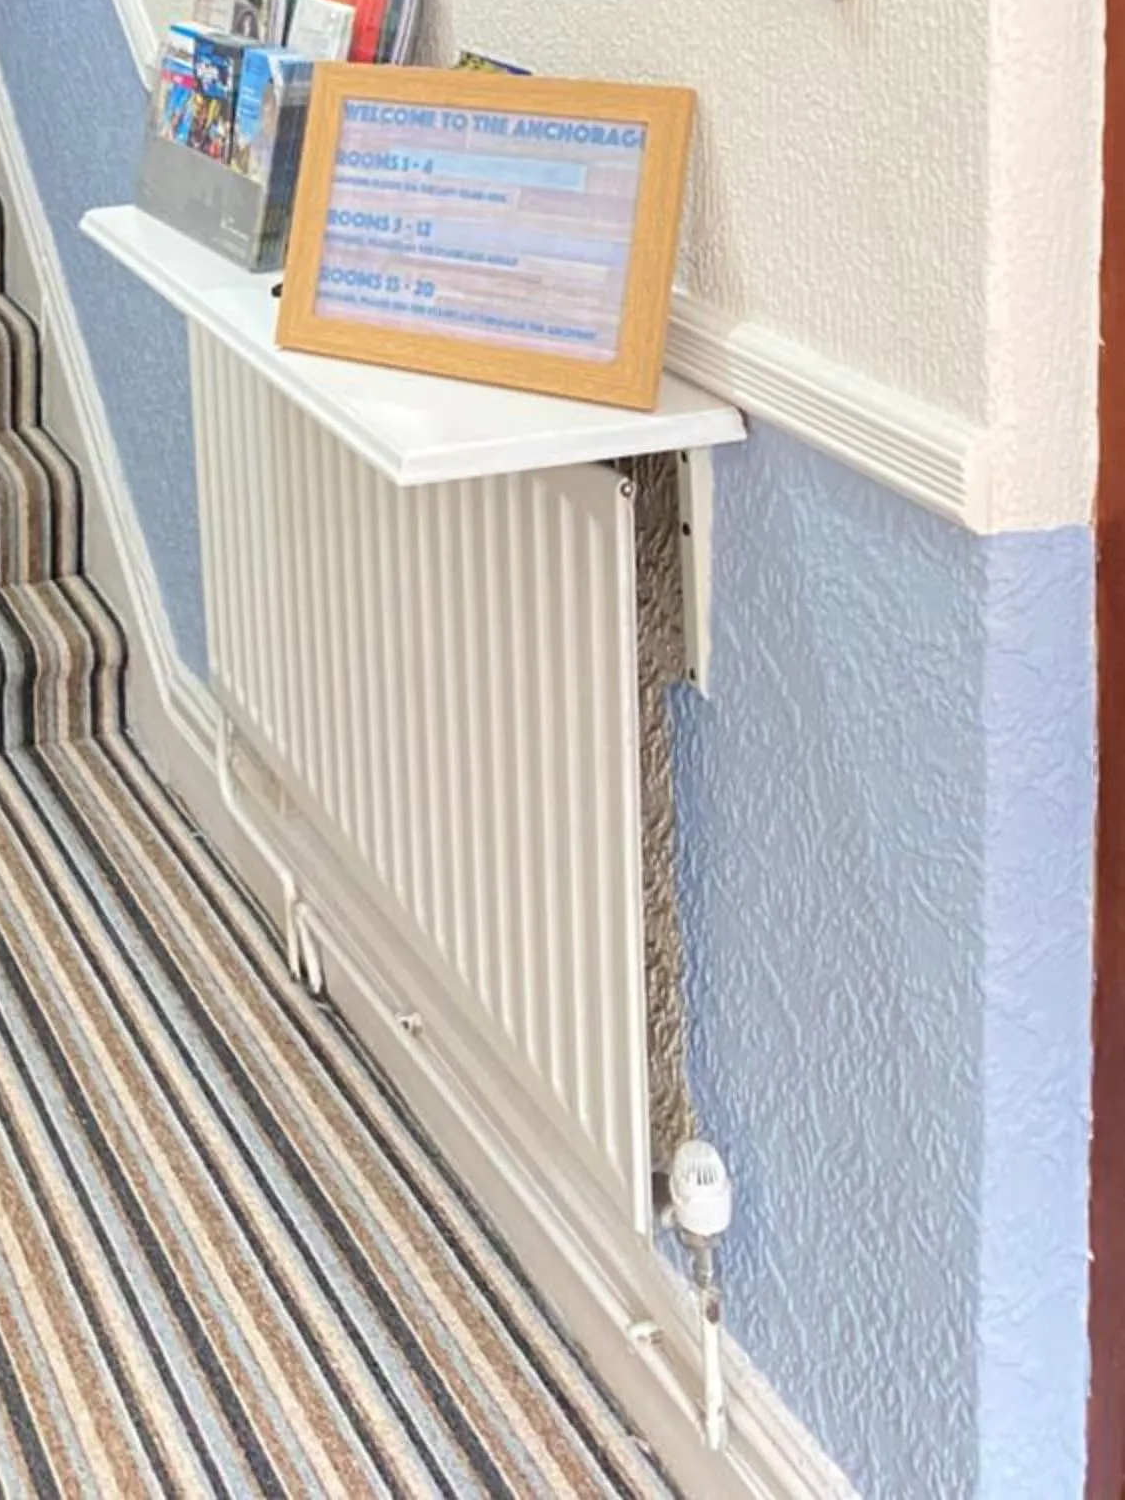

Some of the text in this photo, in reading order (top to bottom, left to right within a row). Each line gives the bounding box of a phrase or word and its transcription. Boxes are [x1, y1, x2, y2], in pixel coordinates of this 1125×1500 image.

[346, 104, 435, 128] WELCOME
[442, 112, 467, 130] TO
[472, 115, 508, 135] THE
[336, 150, 398, 171] ROOMS
[326, 209, 389, 232] ROOMS
[320, 264, 382, 290] ROOMS
